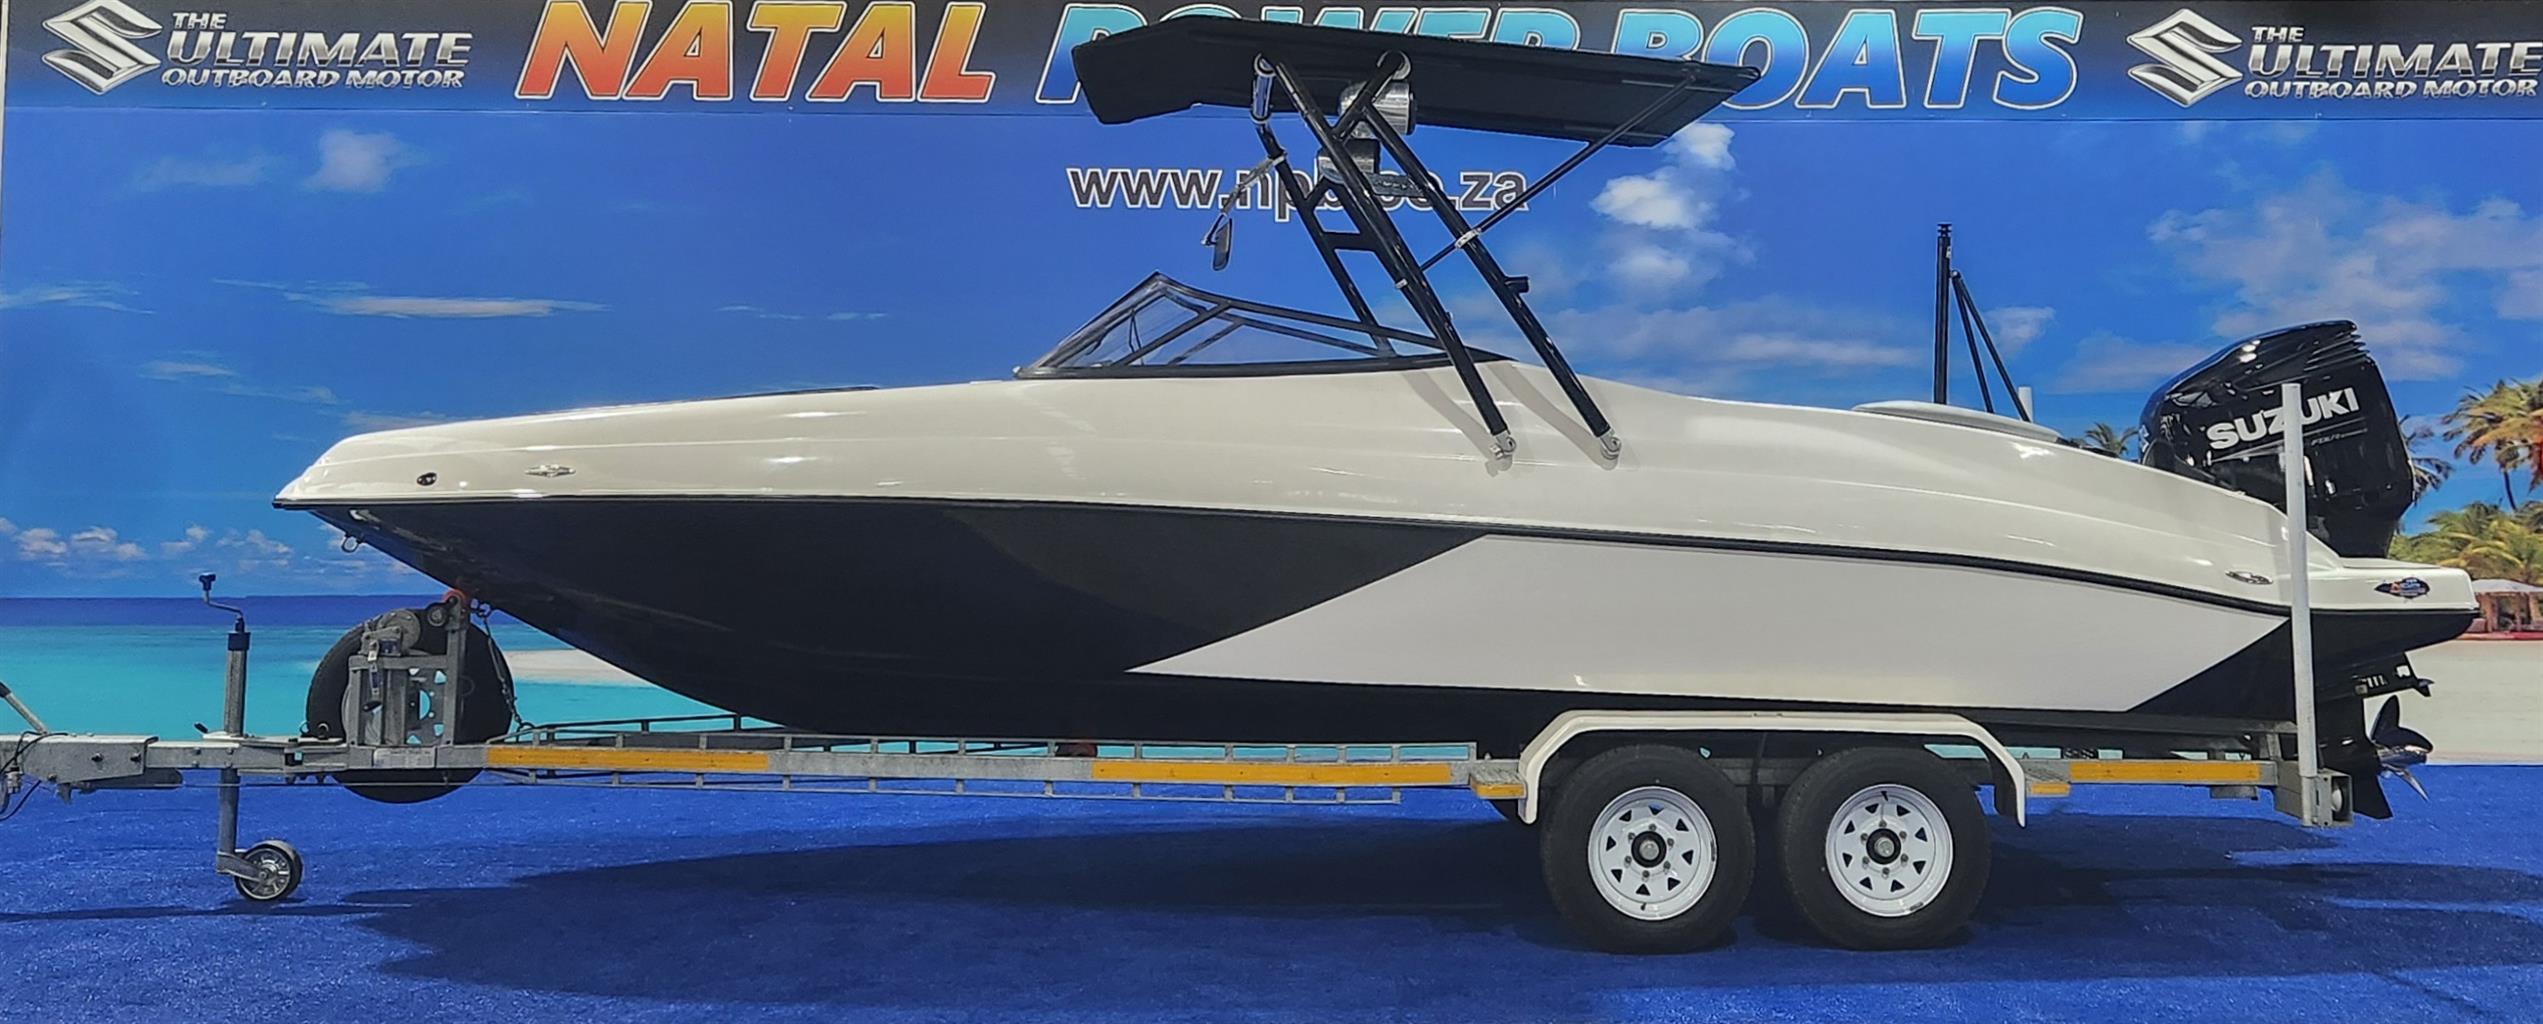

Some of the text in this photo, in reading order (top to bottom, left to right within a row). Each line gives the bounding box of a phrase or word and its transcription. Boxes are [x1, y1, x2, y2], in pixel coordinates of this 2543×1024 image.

[172, 12, 227, 30] THE
[2251, 26, 2304, 43] THE
[166, 30, 473, 67] ULTIMATE
[514, 0, 997, 102] NATAL
[2248, 42, 2543, 78] ULTIMATE
[161, 68, 466, 88] OUTBOARD MOTOR
[2244, 78, 2538, 99] OUTBOARD MOTOR
[2206, 387, 2360, 450] SUZUKI
